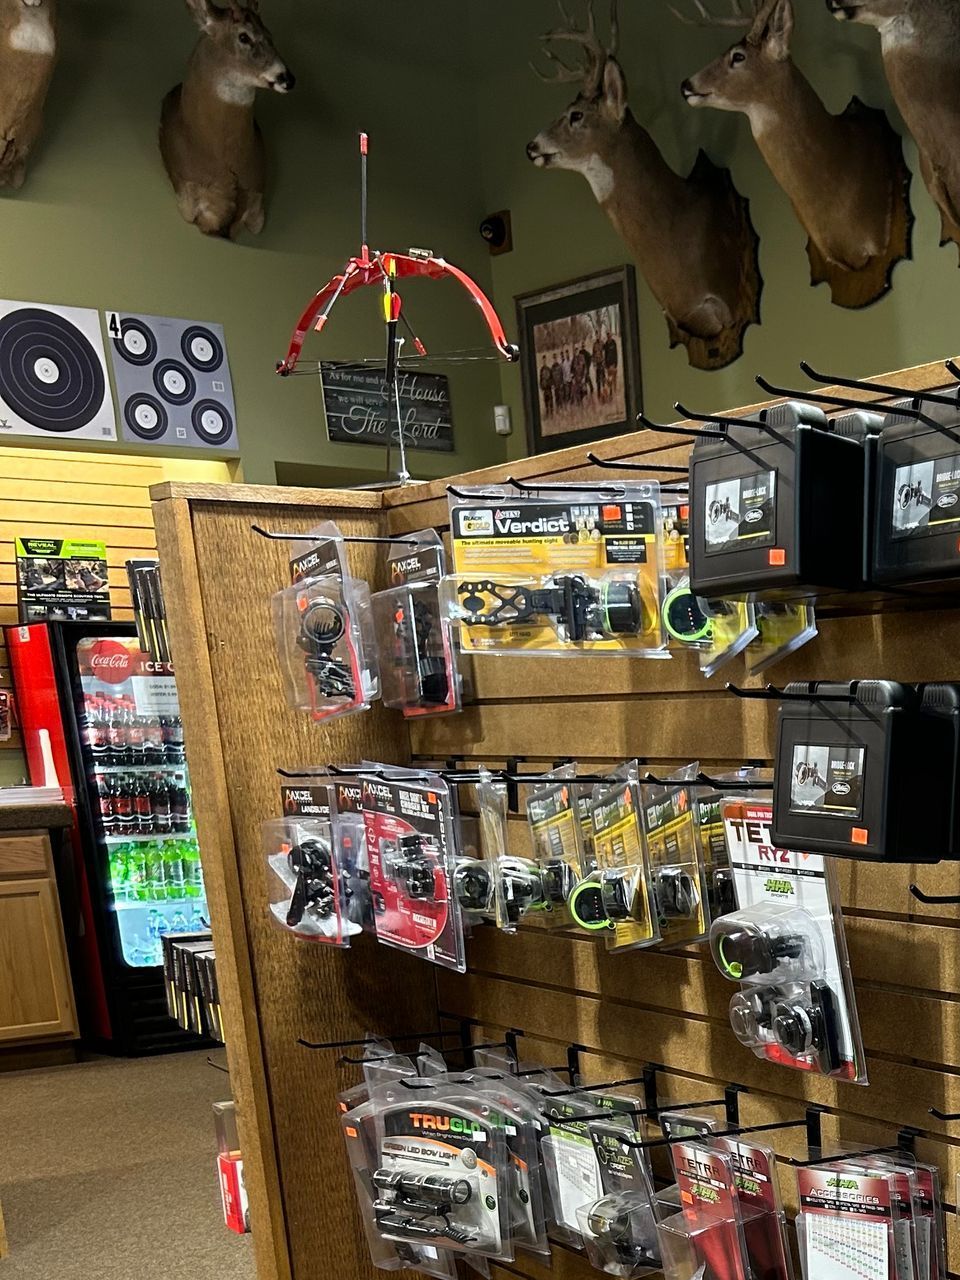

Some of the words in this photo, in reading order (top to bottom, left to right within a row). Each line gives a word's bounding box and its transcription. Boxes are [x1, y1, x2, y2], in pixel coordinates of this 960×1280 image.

[109, 313, 119, 337] 4
[329, 372, 340, 380] As
[341, 372, 352, 381] for
[353, 375, 364, 383] me
[366, 374, 379, 384] and
[382, 373, 448, 402] House
[341, 405, 386, 434] The
[391, 408, 441, 446] Lord
[495, 517, 569, 534] Verdict
[522, 538, 542, 546] hunting
[91, 653, 130, 668] Coca-Cola
[140, 662, 163, 672] ICE
[758, 845, 790, 863] RYZ
[383, 1142, 406, 1151] GREEN
[407, 1145, 420, 1154] LED
[440, 1152, 459, 1160] LIGHT
[809, 1188, 880, 1204] ACCESSORIES
